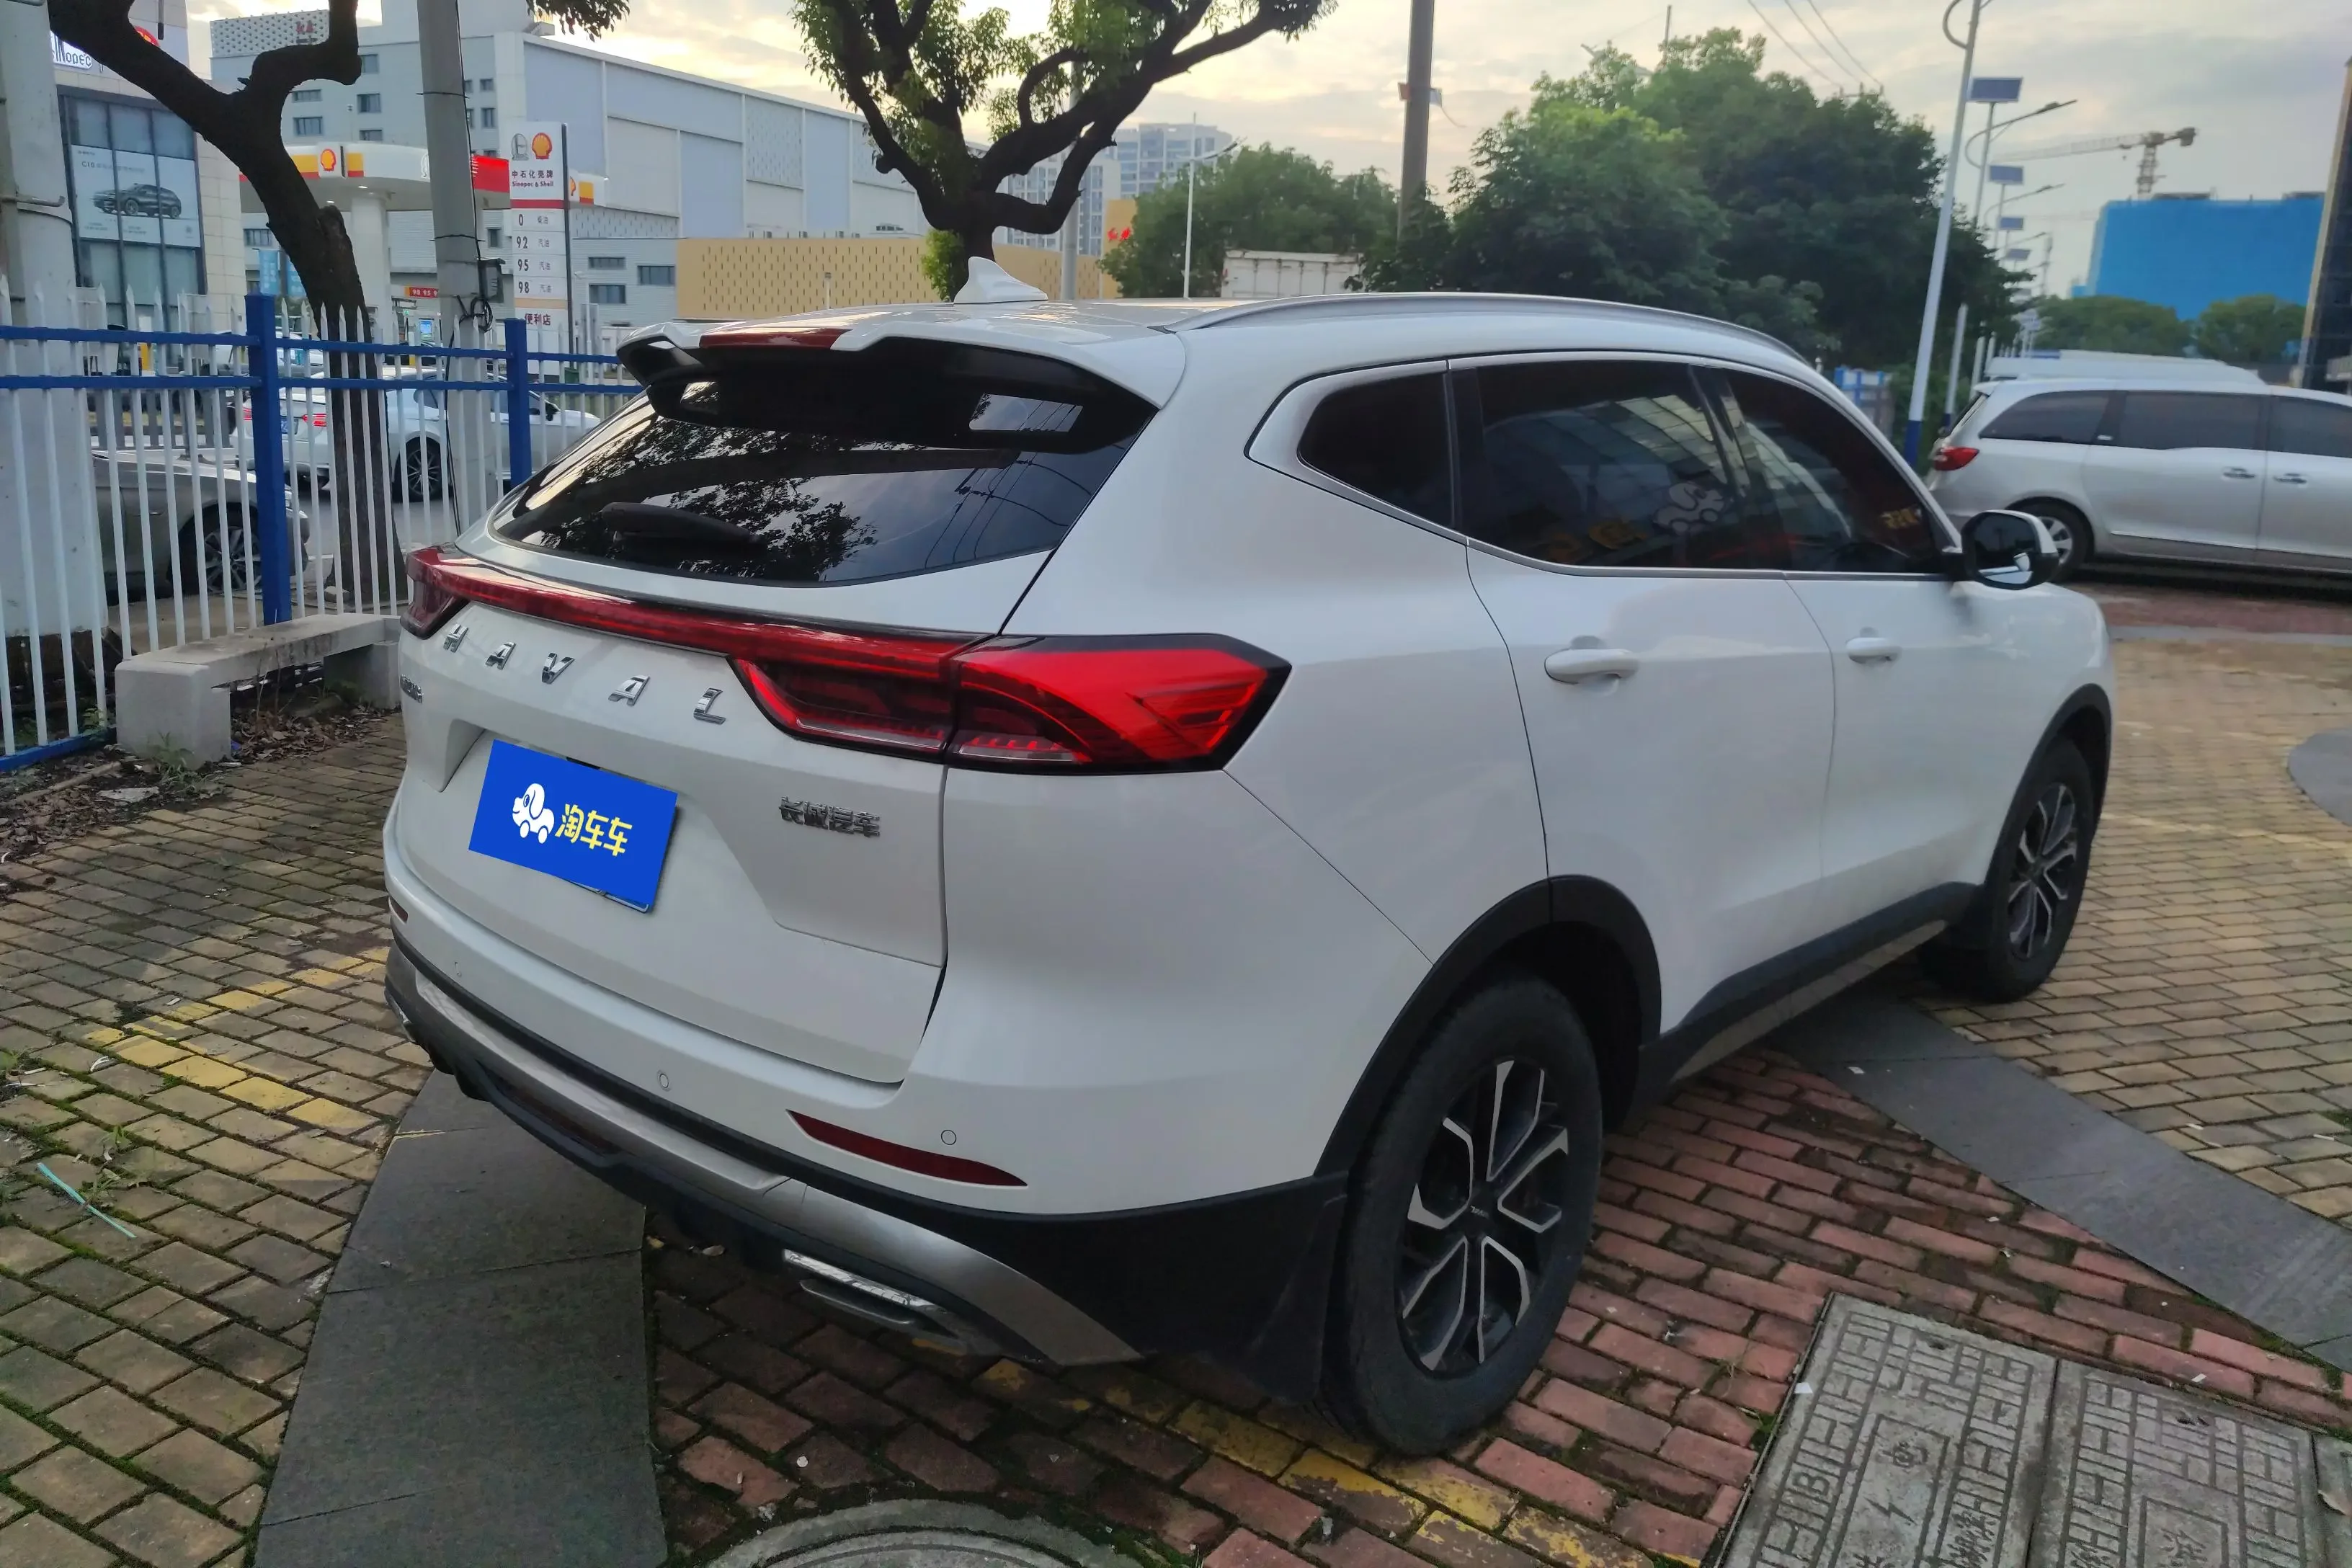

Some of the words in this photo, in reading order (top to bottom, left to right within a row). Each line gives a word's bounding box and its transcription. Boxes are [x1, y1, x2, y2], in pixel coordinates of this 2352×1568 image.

[512, 169, 553, 179] 中石化壳牌
[518, 214, 524, 226] 0
[516, 236, 528, 249] 92
[517, 259, 529, 272] 95
[518, 281, 530, 294] 98
[525, 313, 551, 326] 便利店
[442, 623, 726, 725] HAVAL
[778, 795, 881, 838] 长城汽车
